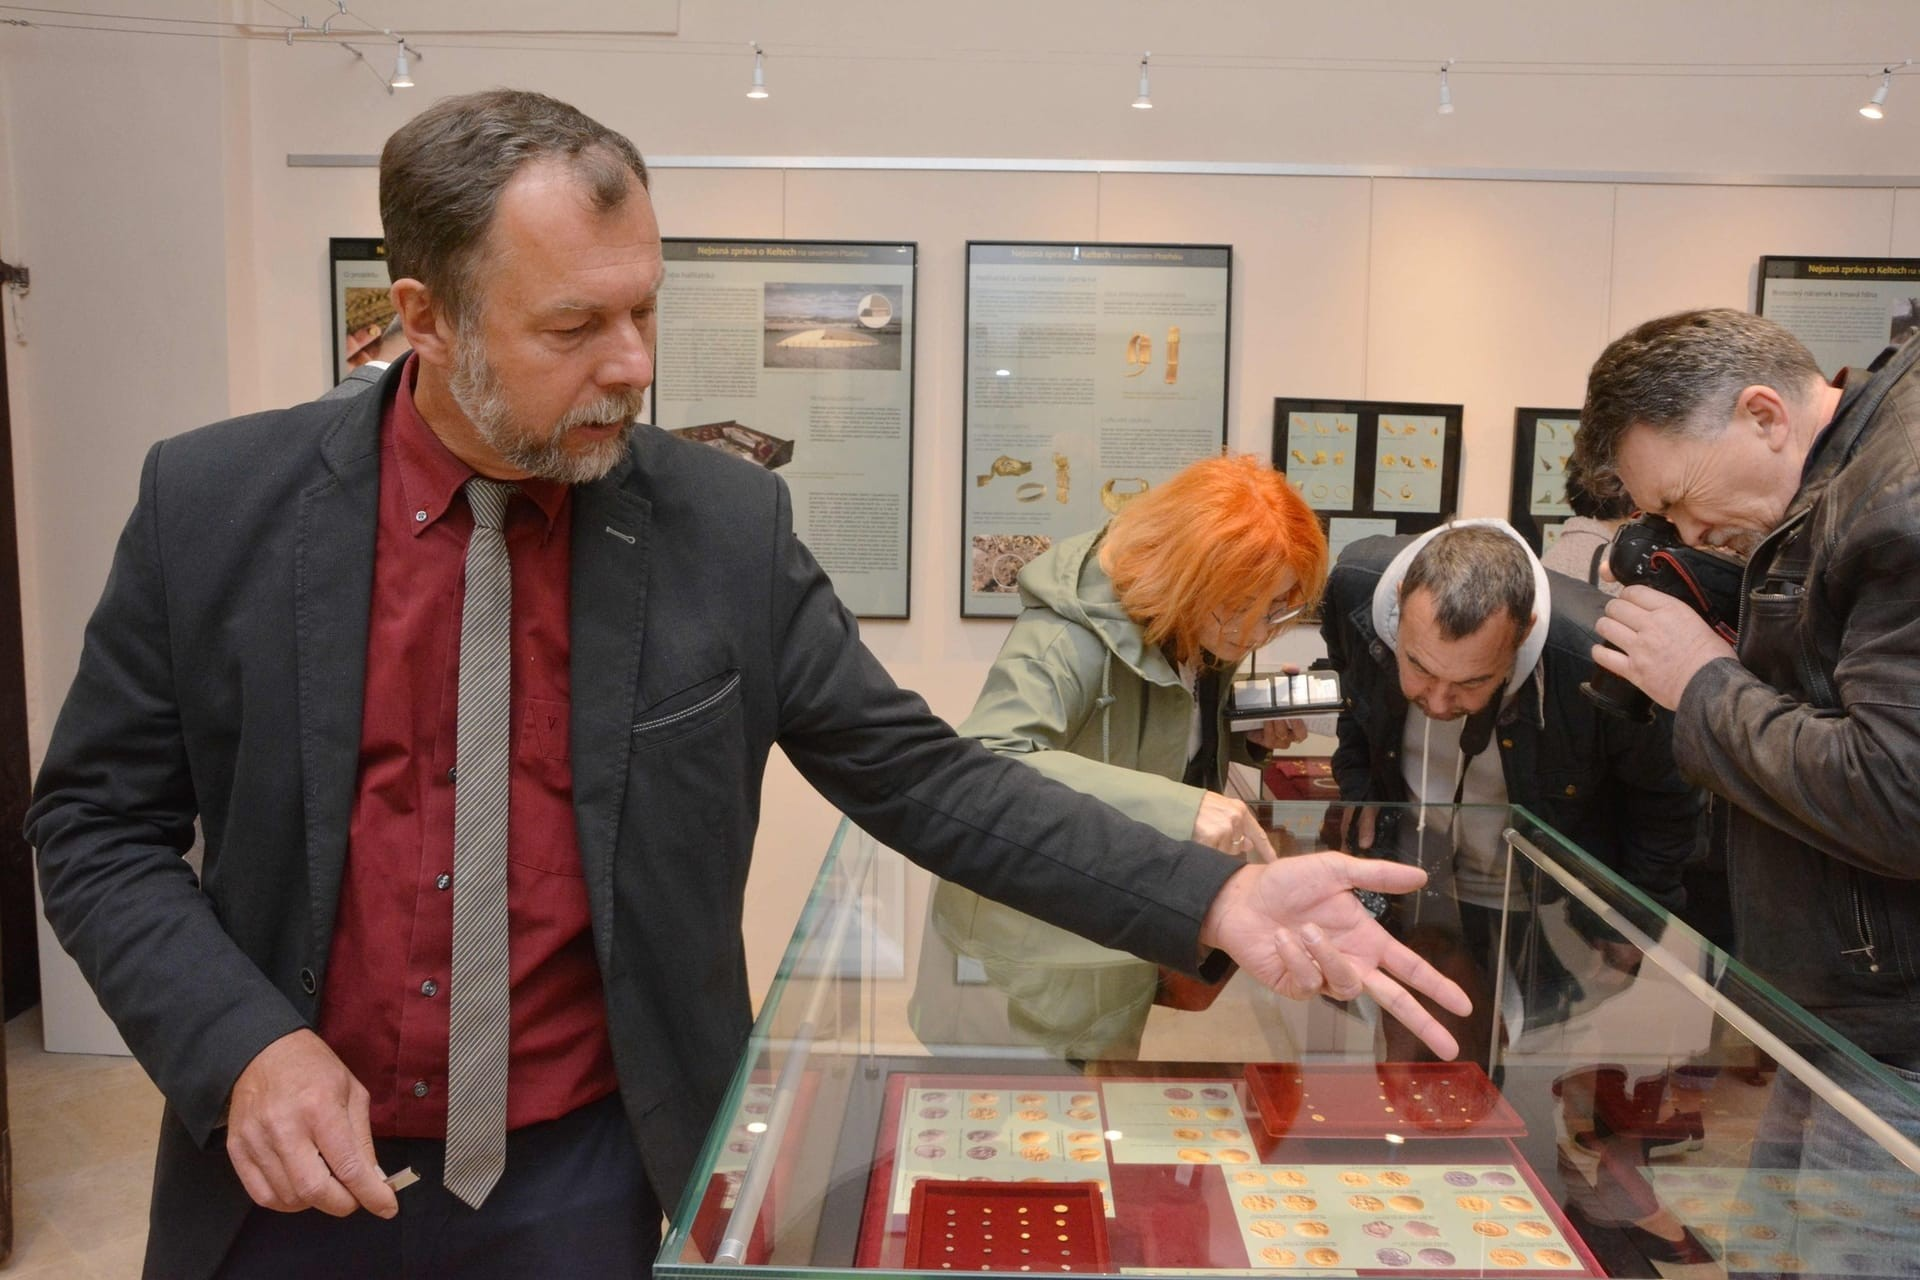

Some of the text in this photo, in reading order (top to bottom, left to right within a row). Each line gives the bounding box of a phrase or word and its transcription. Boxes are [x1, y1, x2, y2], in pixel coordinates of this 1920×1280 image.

[731, 247, 757, 257] zpráva
[766, 247, 796, 256] Keltech
[1808, 264, 1840, 274] Nejasná
[1841, 265, 1868, 275] zpráva
[1876, 266, 1907, 275] Keltech
